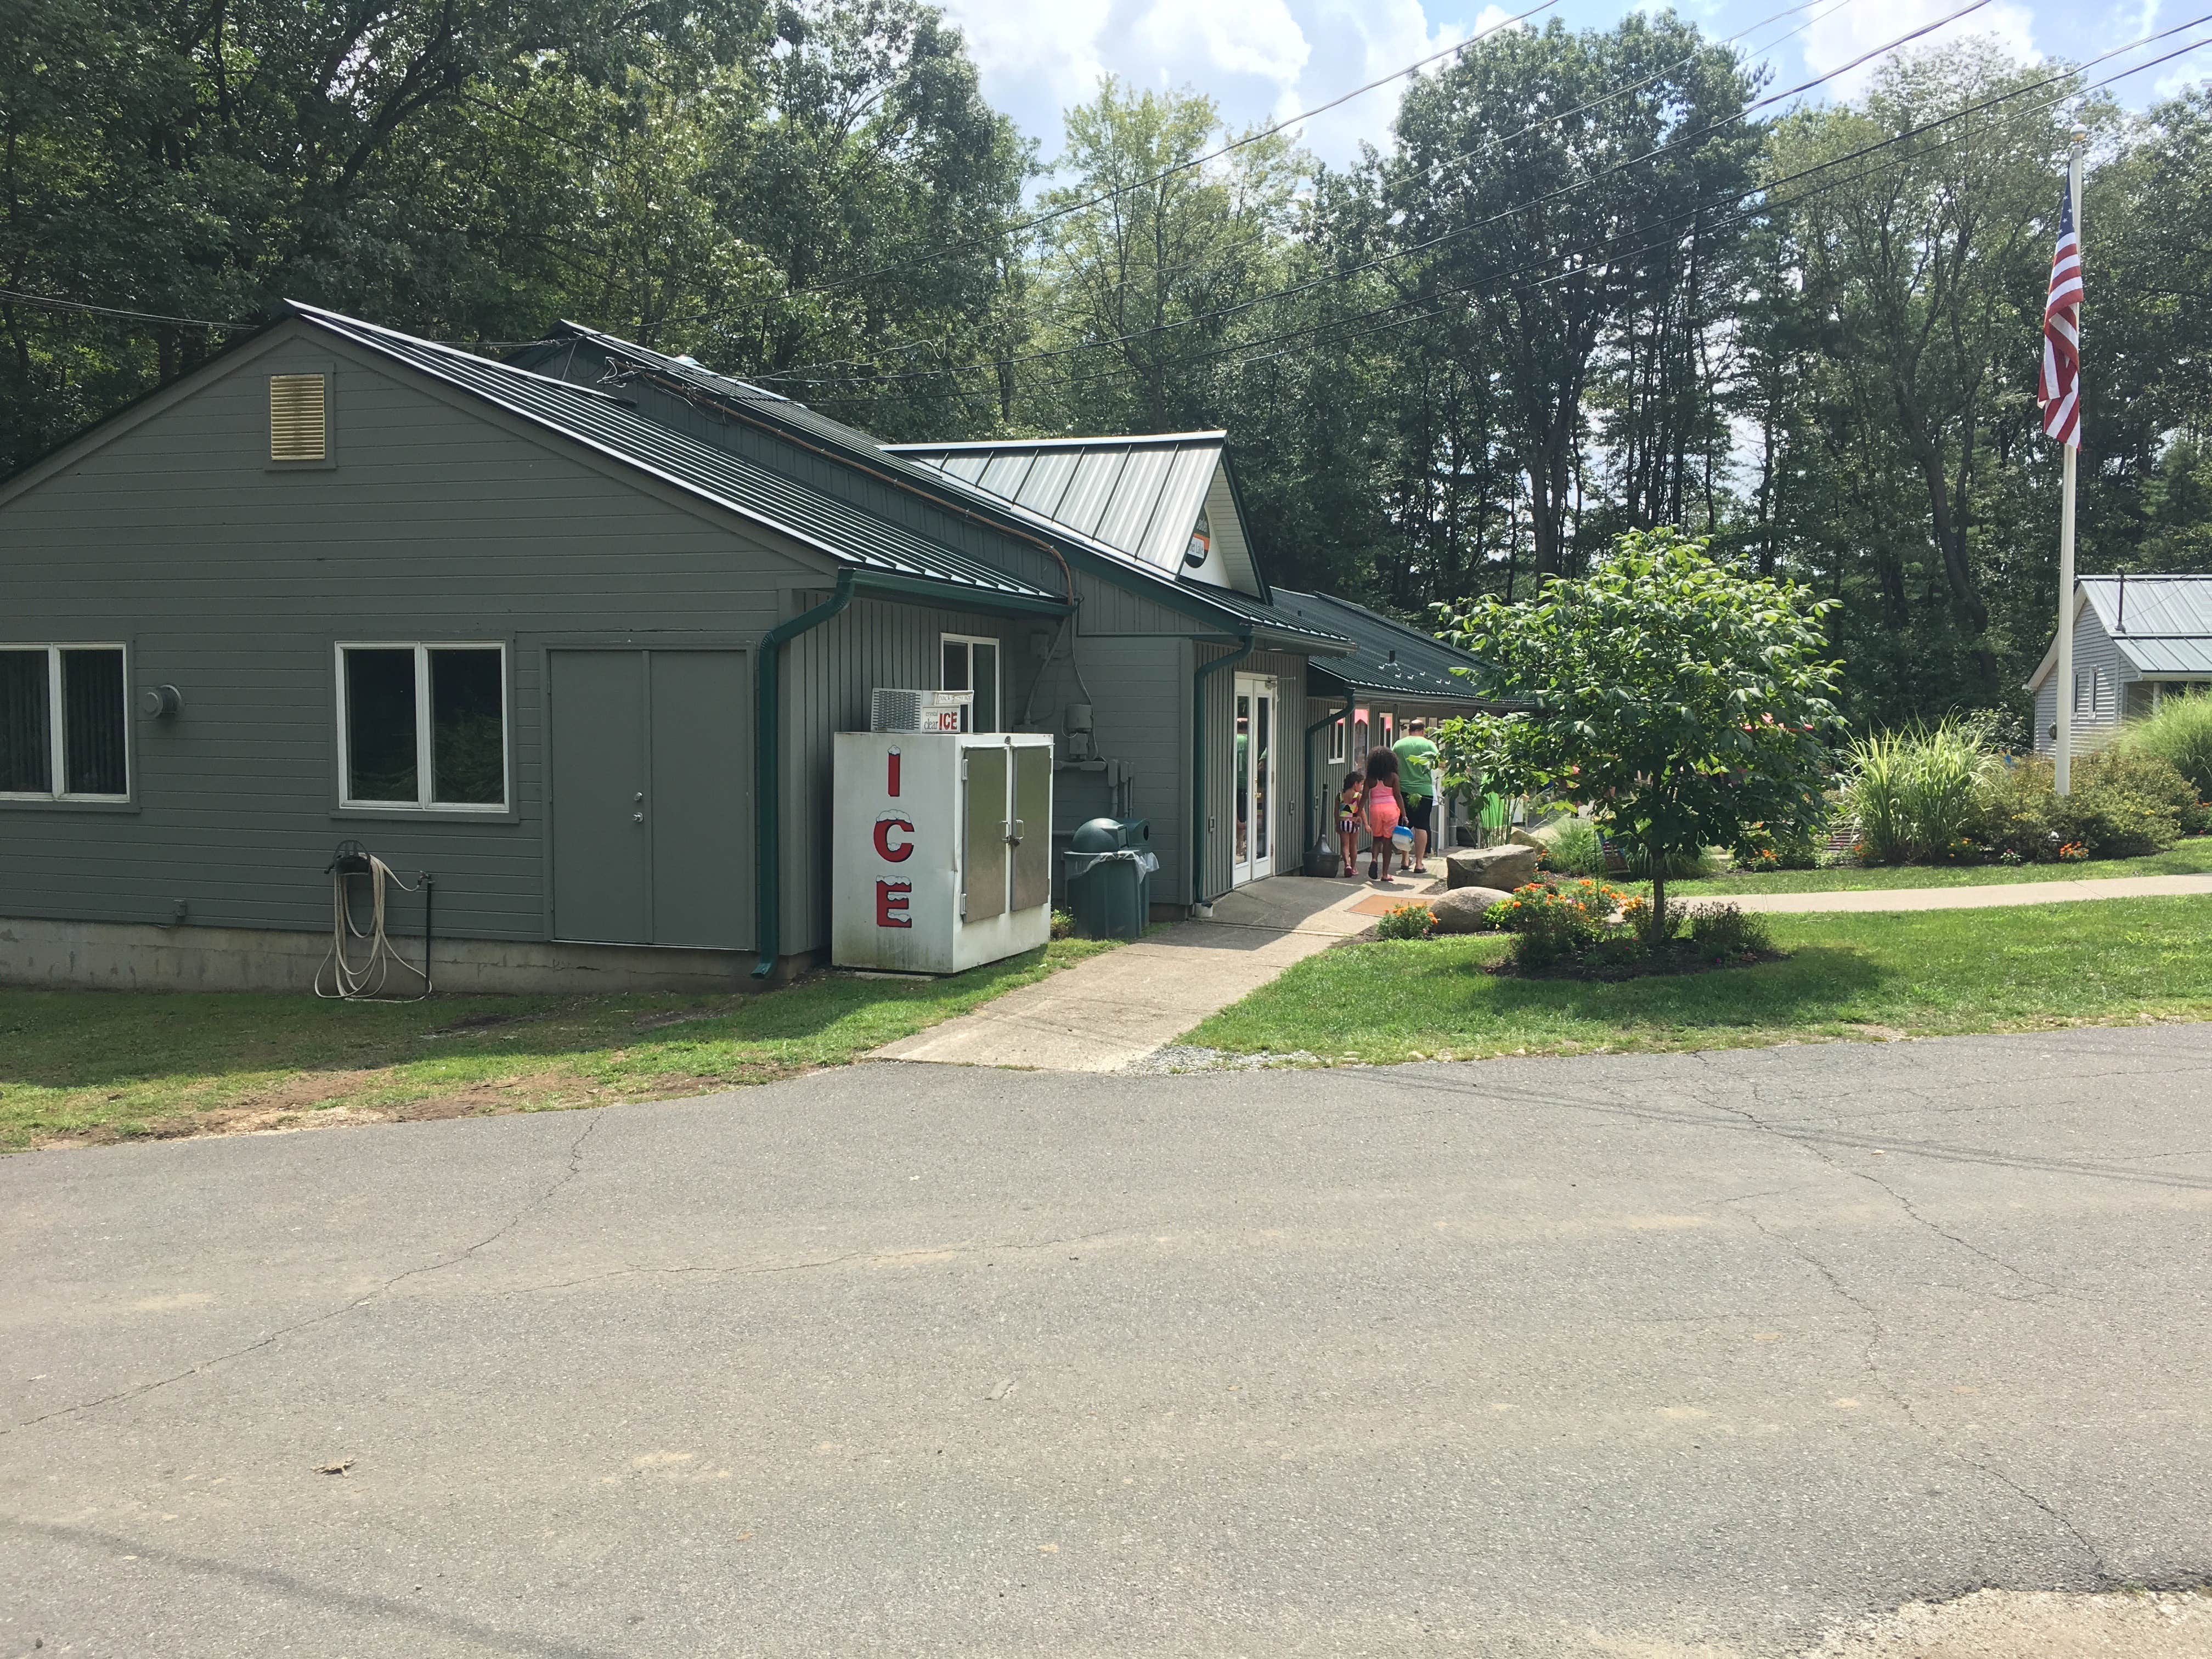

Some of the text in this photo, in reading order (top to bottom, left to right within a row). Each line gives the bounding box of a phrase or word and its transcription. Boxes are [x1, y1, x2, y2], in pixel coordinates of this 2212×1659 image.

[924, 712, 957, 731] clear ICE
[873, 745, 915, 928] ICE
